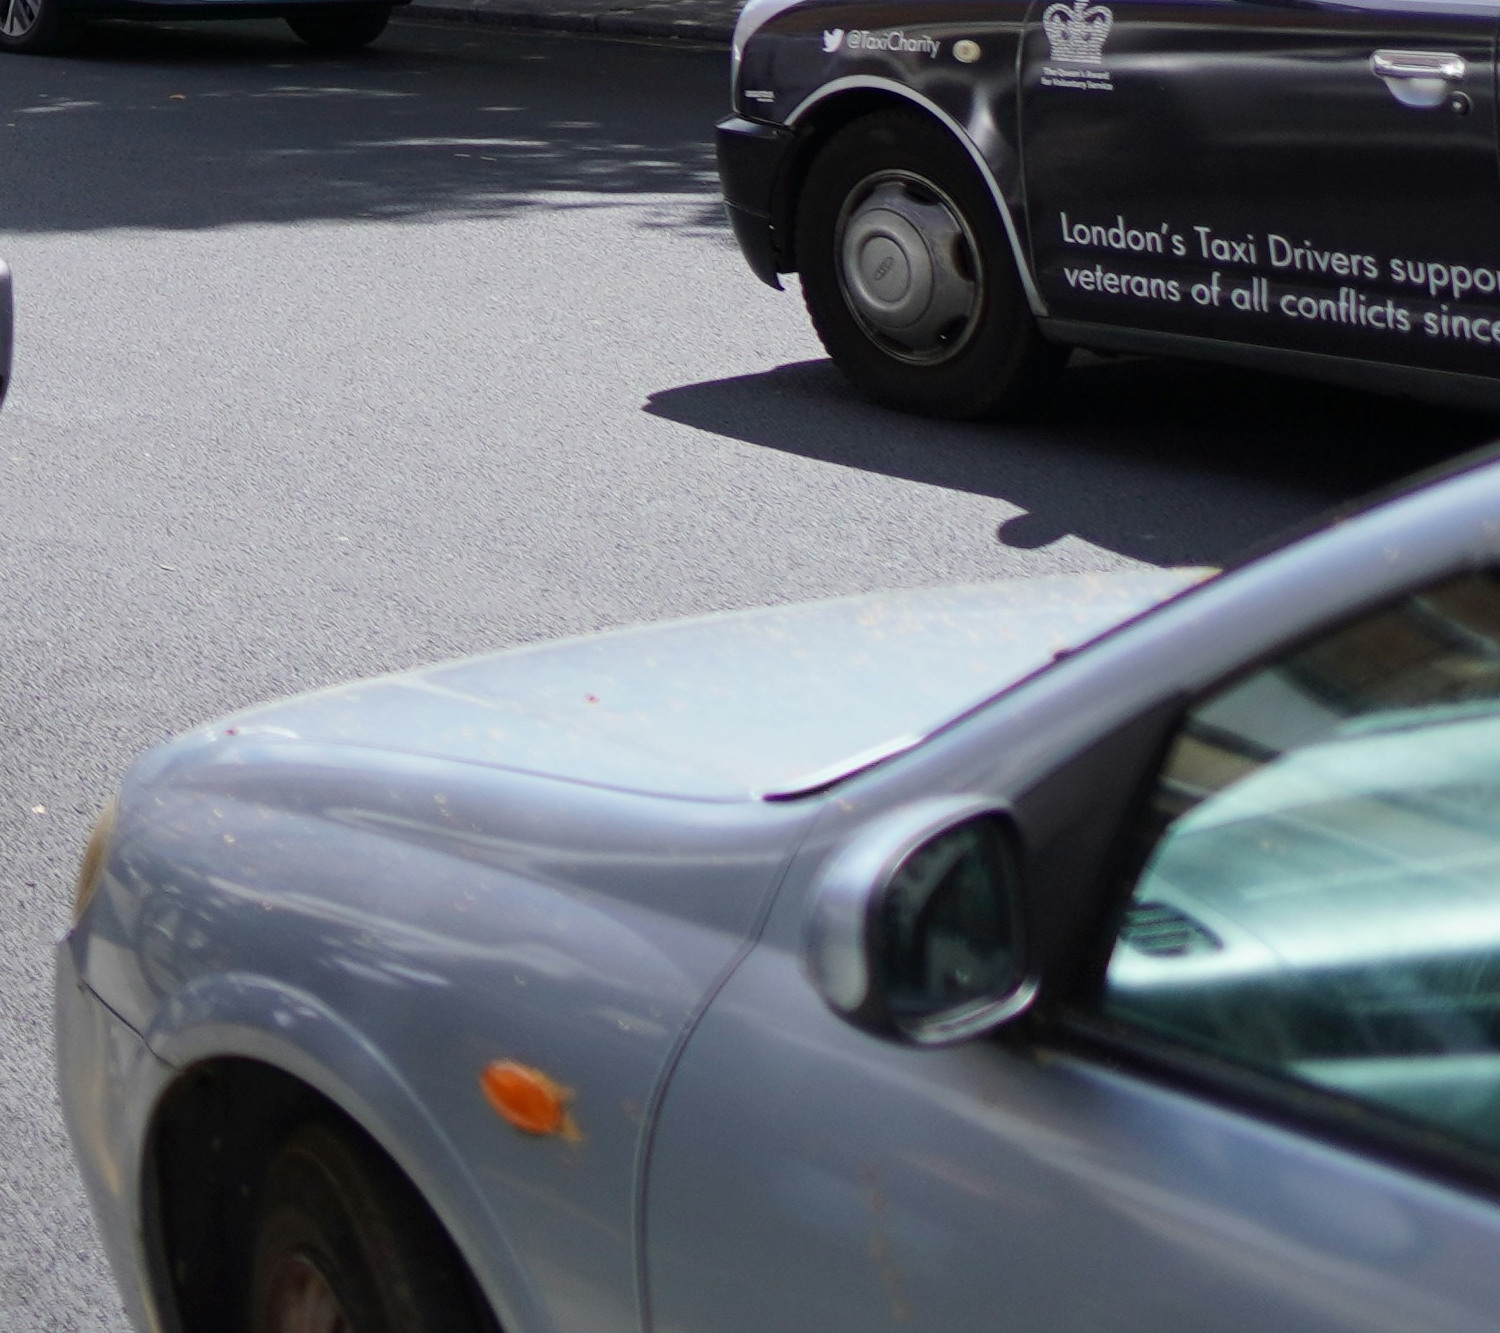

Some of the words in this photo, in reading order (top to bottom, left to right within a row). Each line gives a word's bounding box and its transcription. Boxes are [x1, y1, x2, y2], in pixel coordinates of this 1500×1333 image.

[845, 29, 941, 59] @TaxiCharity
[1059, 211, 1186, 257] London's
[1193, 225, 1257, 265] Taxi
[1268, 233, 1379, 279] Drivers
[1389, 256, 1500, 299] suppo
[1063, 264, 1181, 302] veterans
[1190, 271, 1221, 307] of
[1230, 276, 1269, 313] all
[1280, 286, 1410, 332] conflicts
